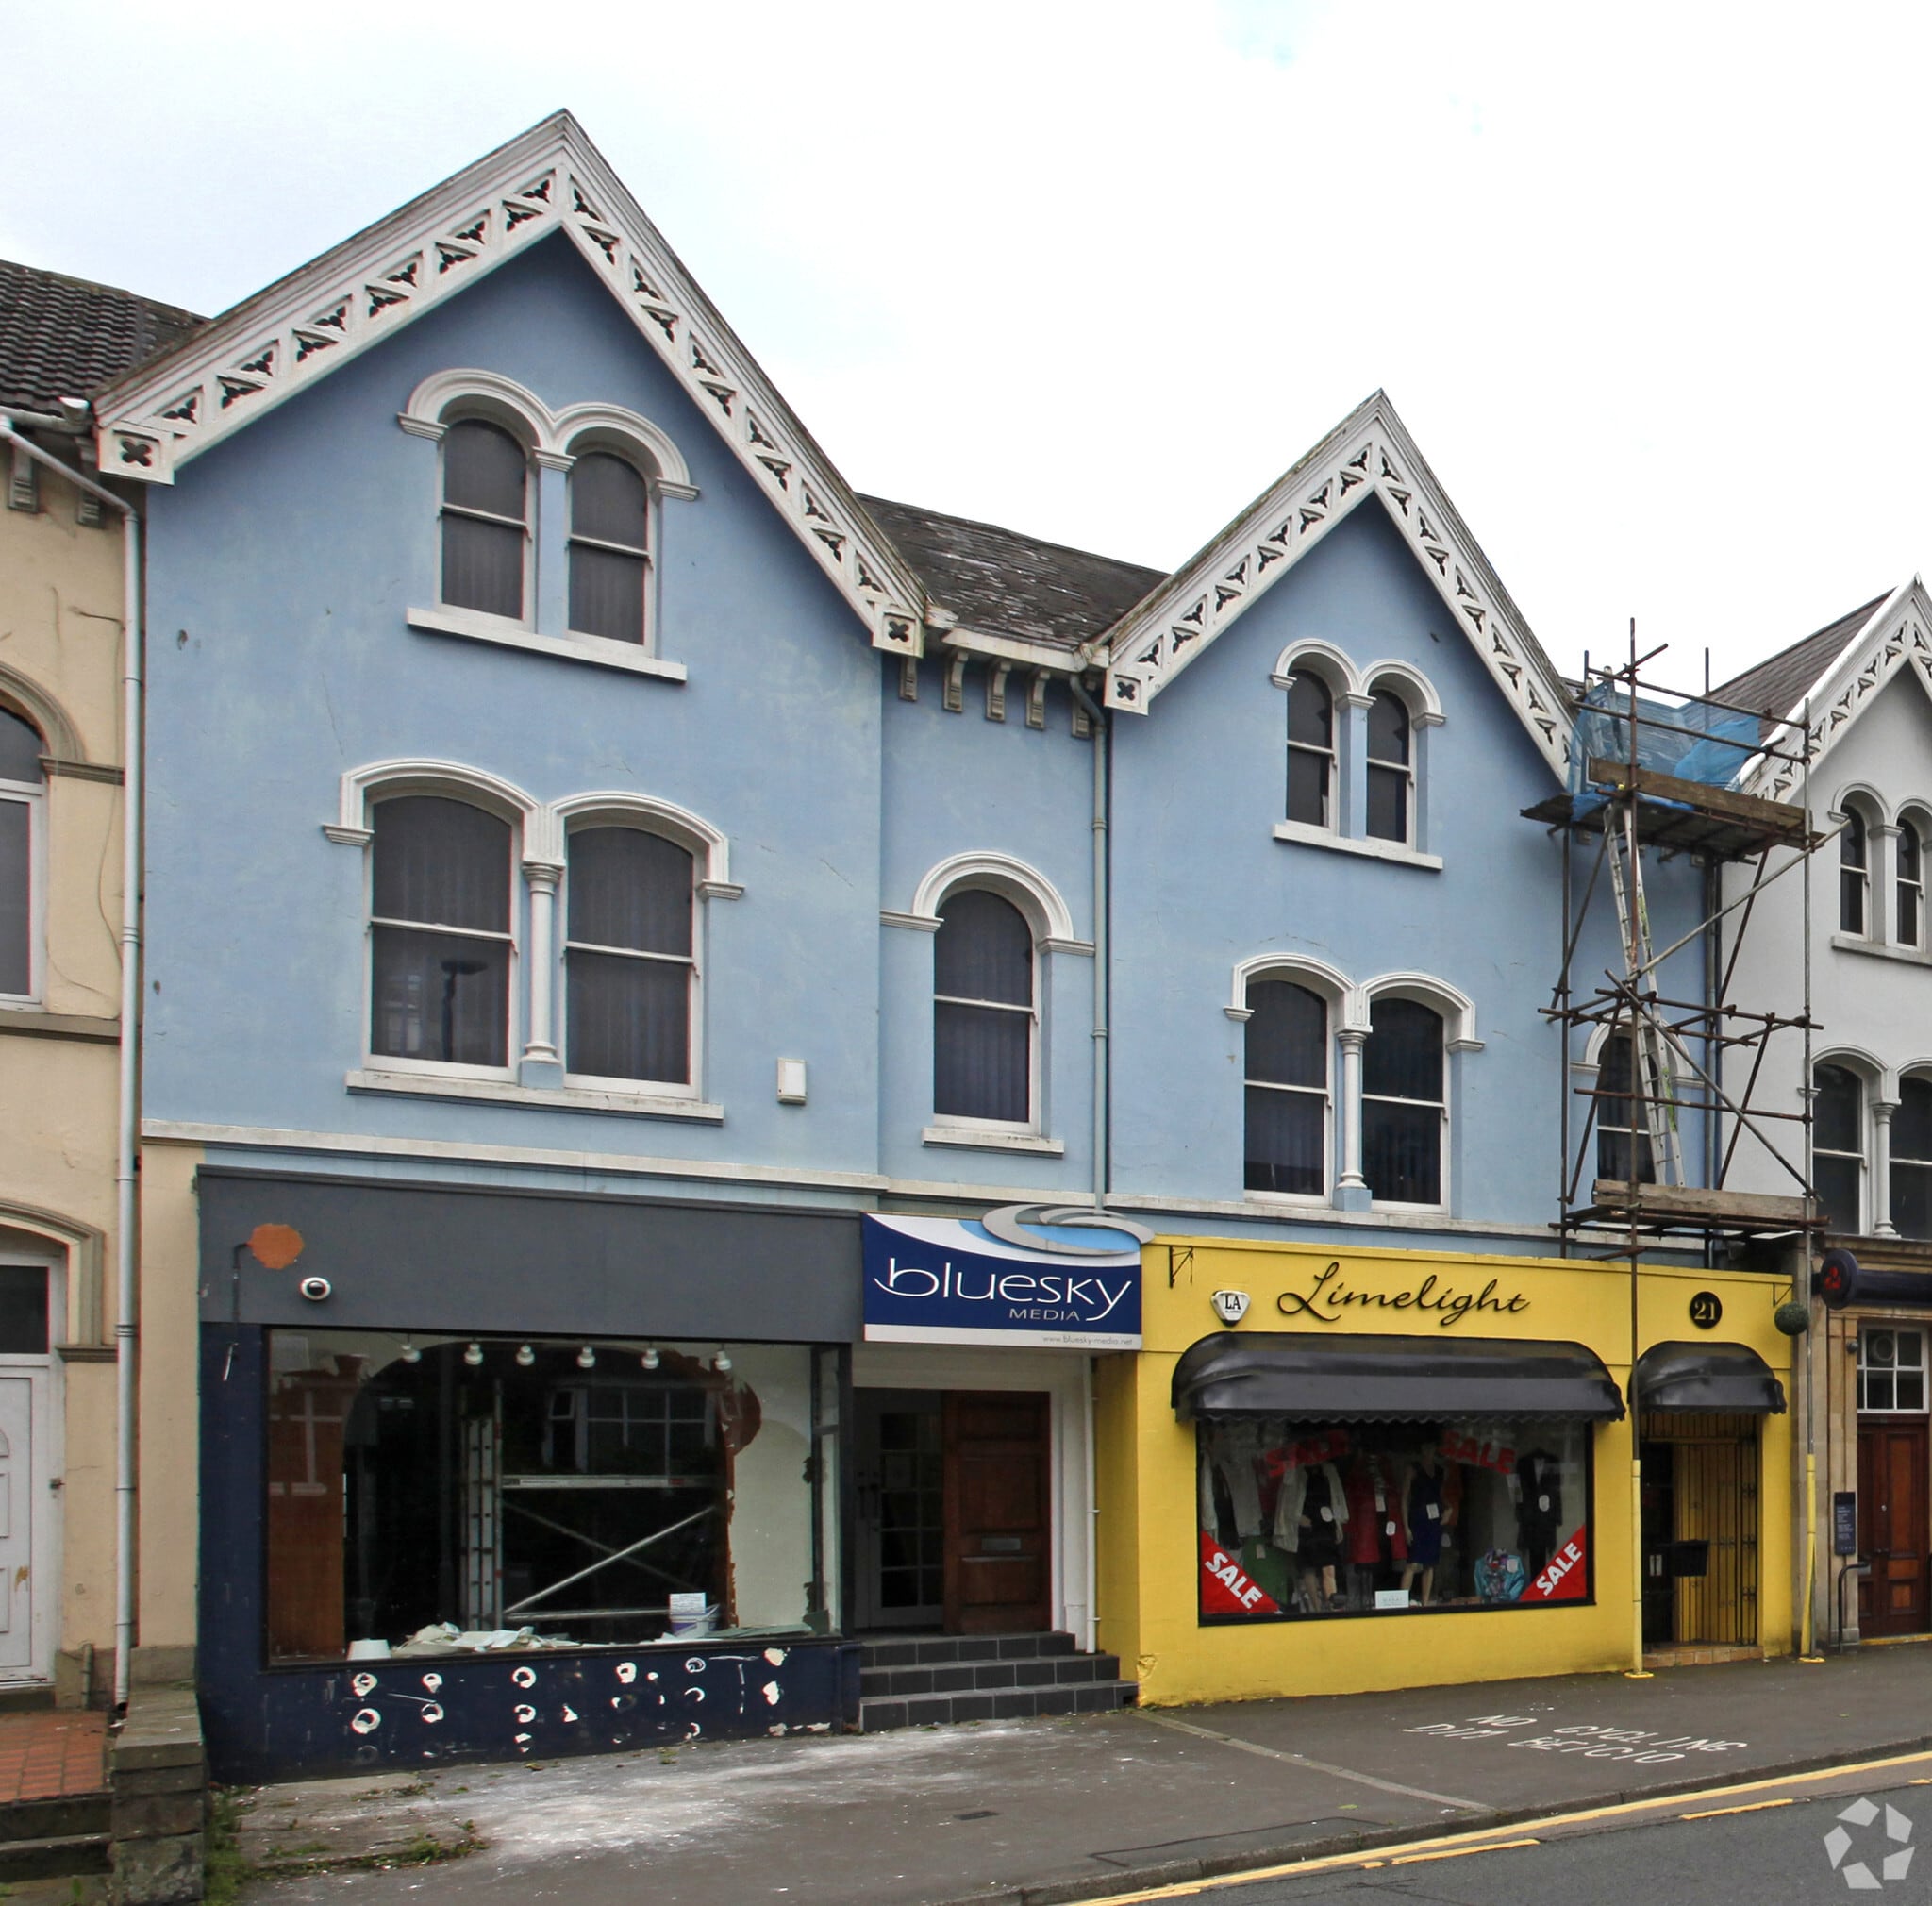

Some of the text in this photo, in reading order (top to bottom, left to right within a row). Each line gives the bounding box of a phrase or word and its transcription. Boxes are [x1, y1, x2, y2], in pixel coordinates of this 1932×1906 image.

[874, 1257, 1133, 1322] bluesky
[1224, 1294, 1241, 1310] LA
[1276, 1261, 1531, 1327] Limelight
[1008, 1307, 1081, 1322] MEDIA
[1693, 1300, 1716, 1320] 21
[1440, 1429, 1517, 1475] SALE
[1205, 1552, 1264, 1609] SALE
[1536, 1541, 1583, 1596] SALE
[1402, 1723, 1510, 1740] DIM
[1465, 1714, 1538, 1727] NO
